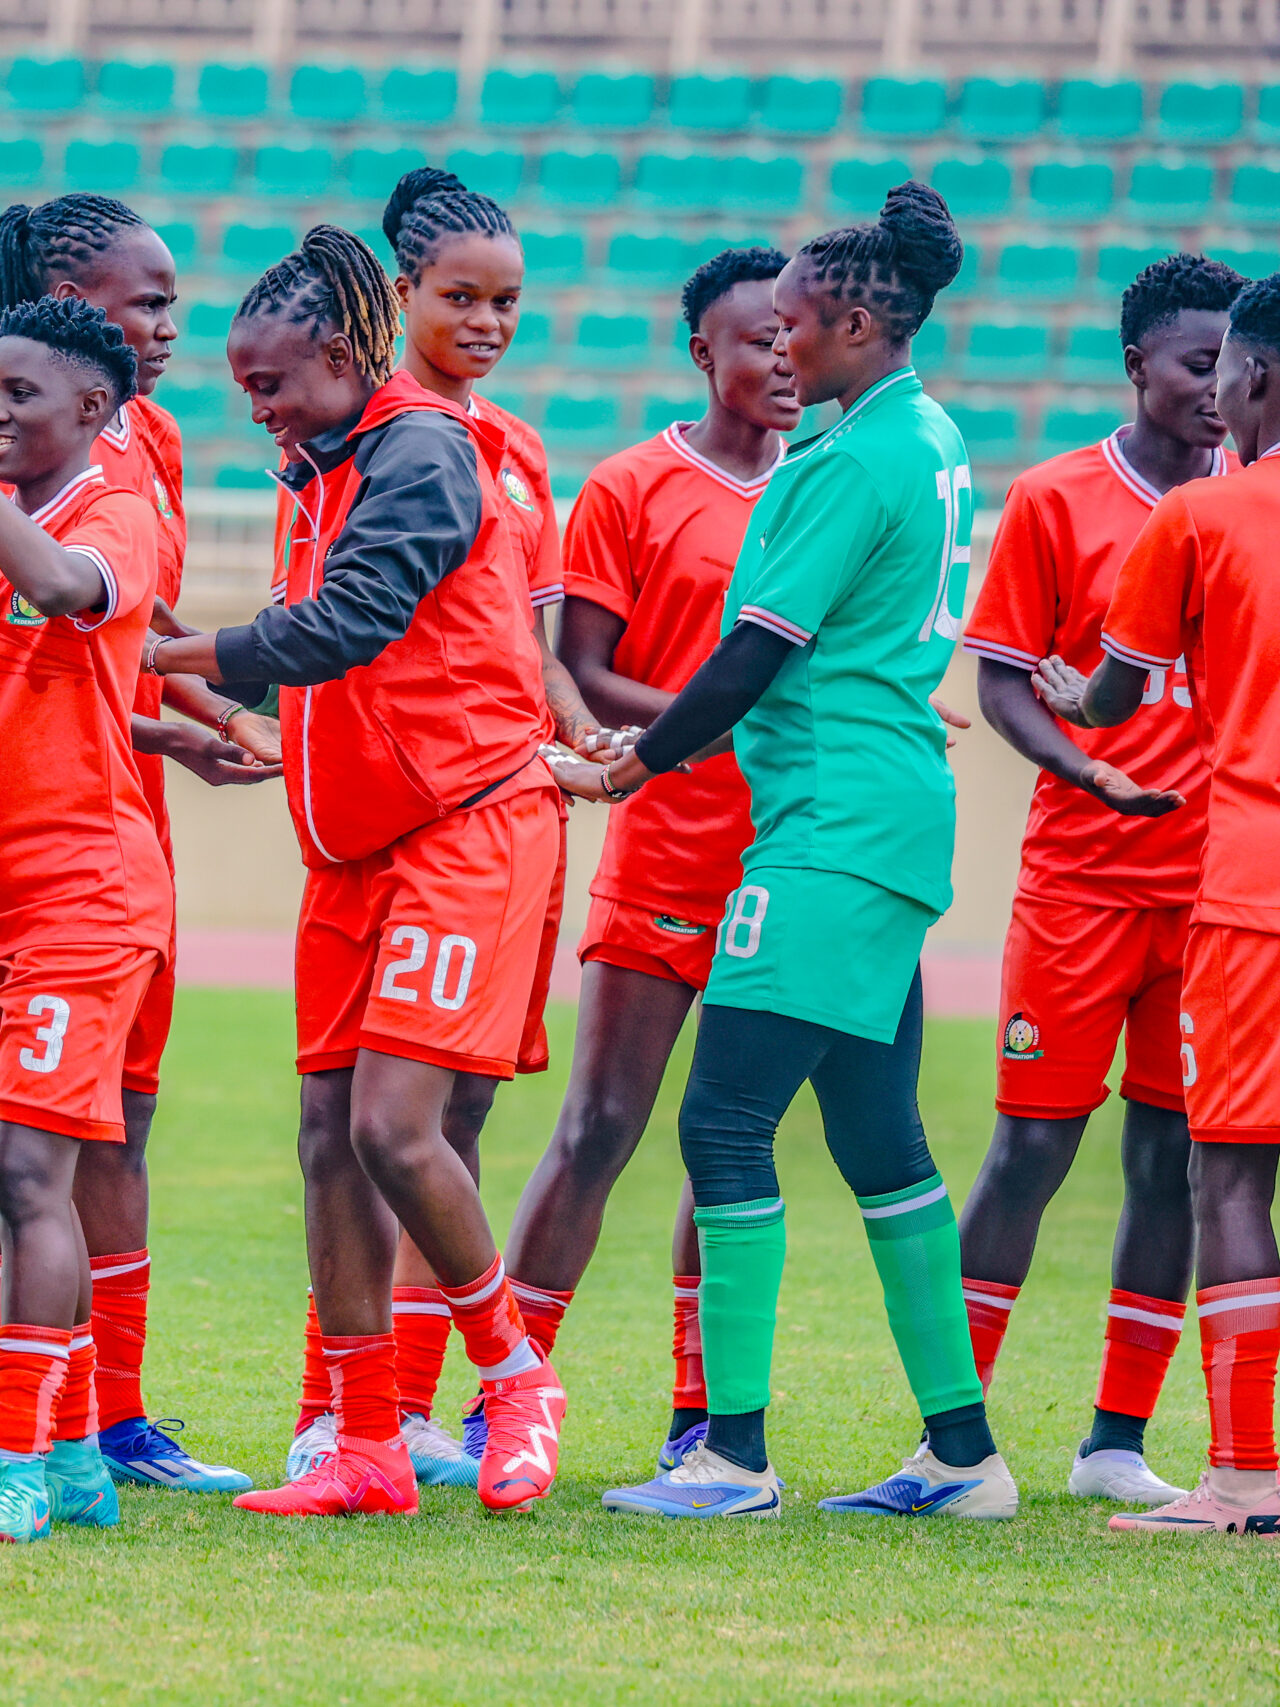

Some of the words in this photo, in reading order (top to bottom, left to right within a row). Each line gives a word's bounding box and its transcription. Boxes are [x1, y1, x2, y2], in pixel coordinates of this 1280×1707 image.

[379, 925, 477, 1011] 20
[662, 923, 698, 934] FEDERATION
[19, 994, 71, 1074] 3
